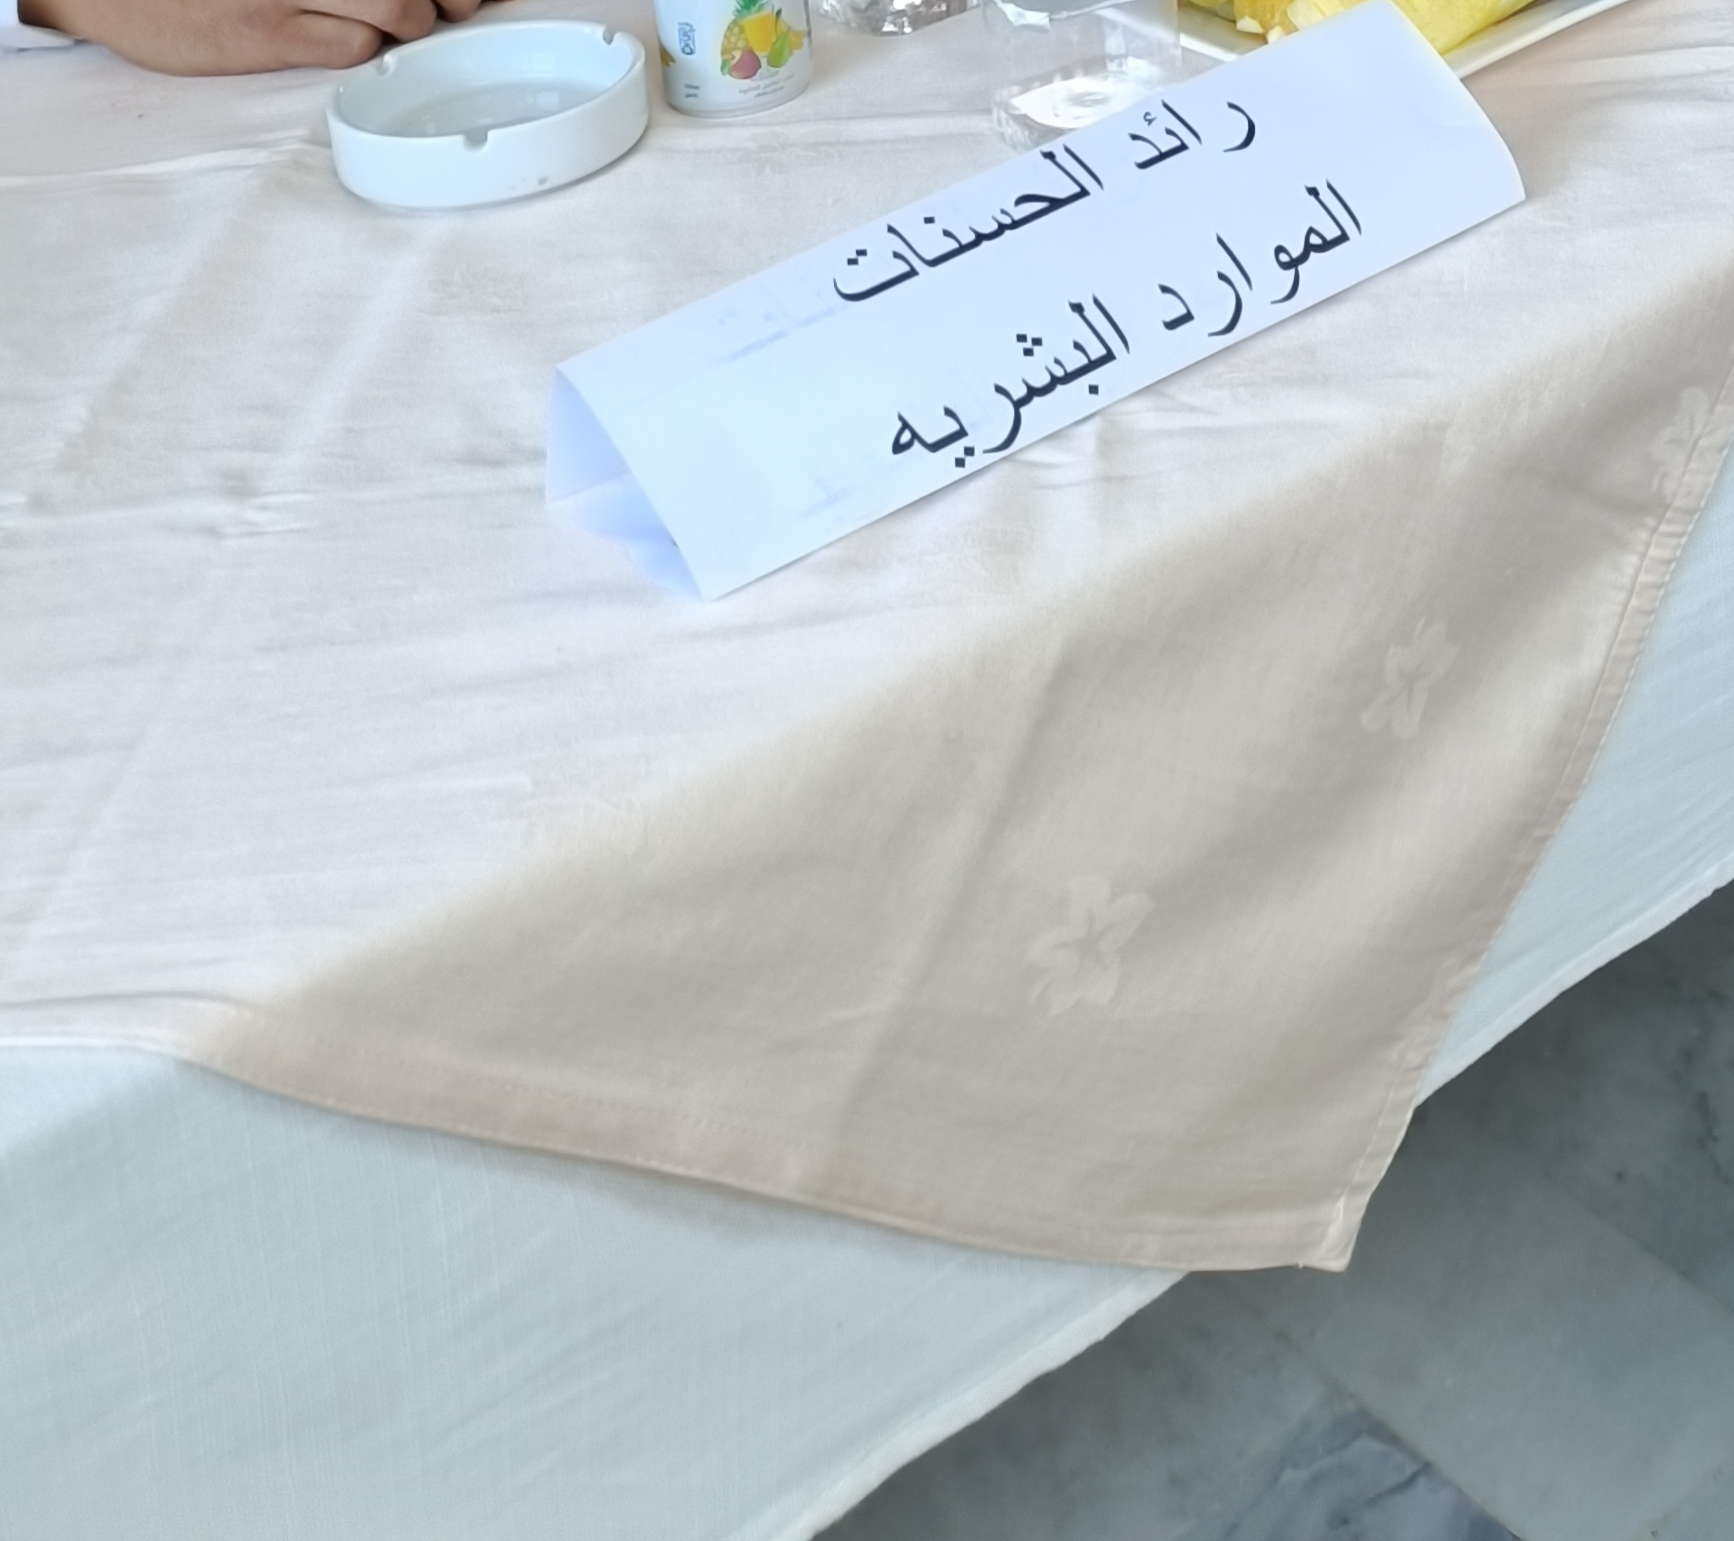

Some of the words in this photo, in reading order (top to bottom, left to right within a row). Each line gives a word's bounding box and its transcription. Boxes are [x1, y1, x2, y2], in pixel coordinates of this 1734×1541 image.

[1129, 101, 1256, 170] رائد
[833, 145, 1103, 303] الحسنات
[1158, 181, 1362, 337] الموارد
[891, 296, 1130, 468] البشريه
